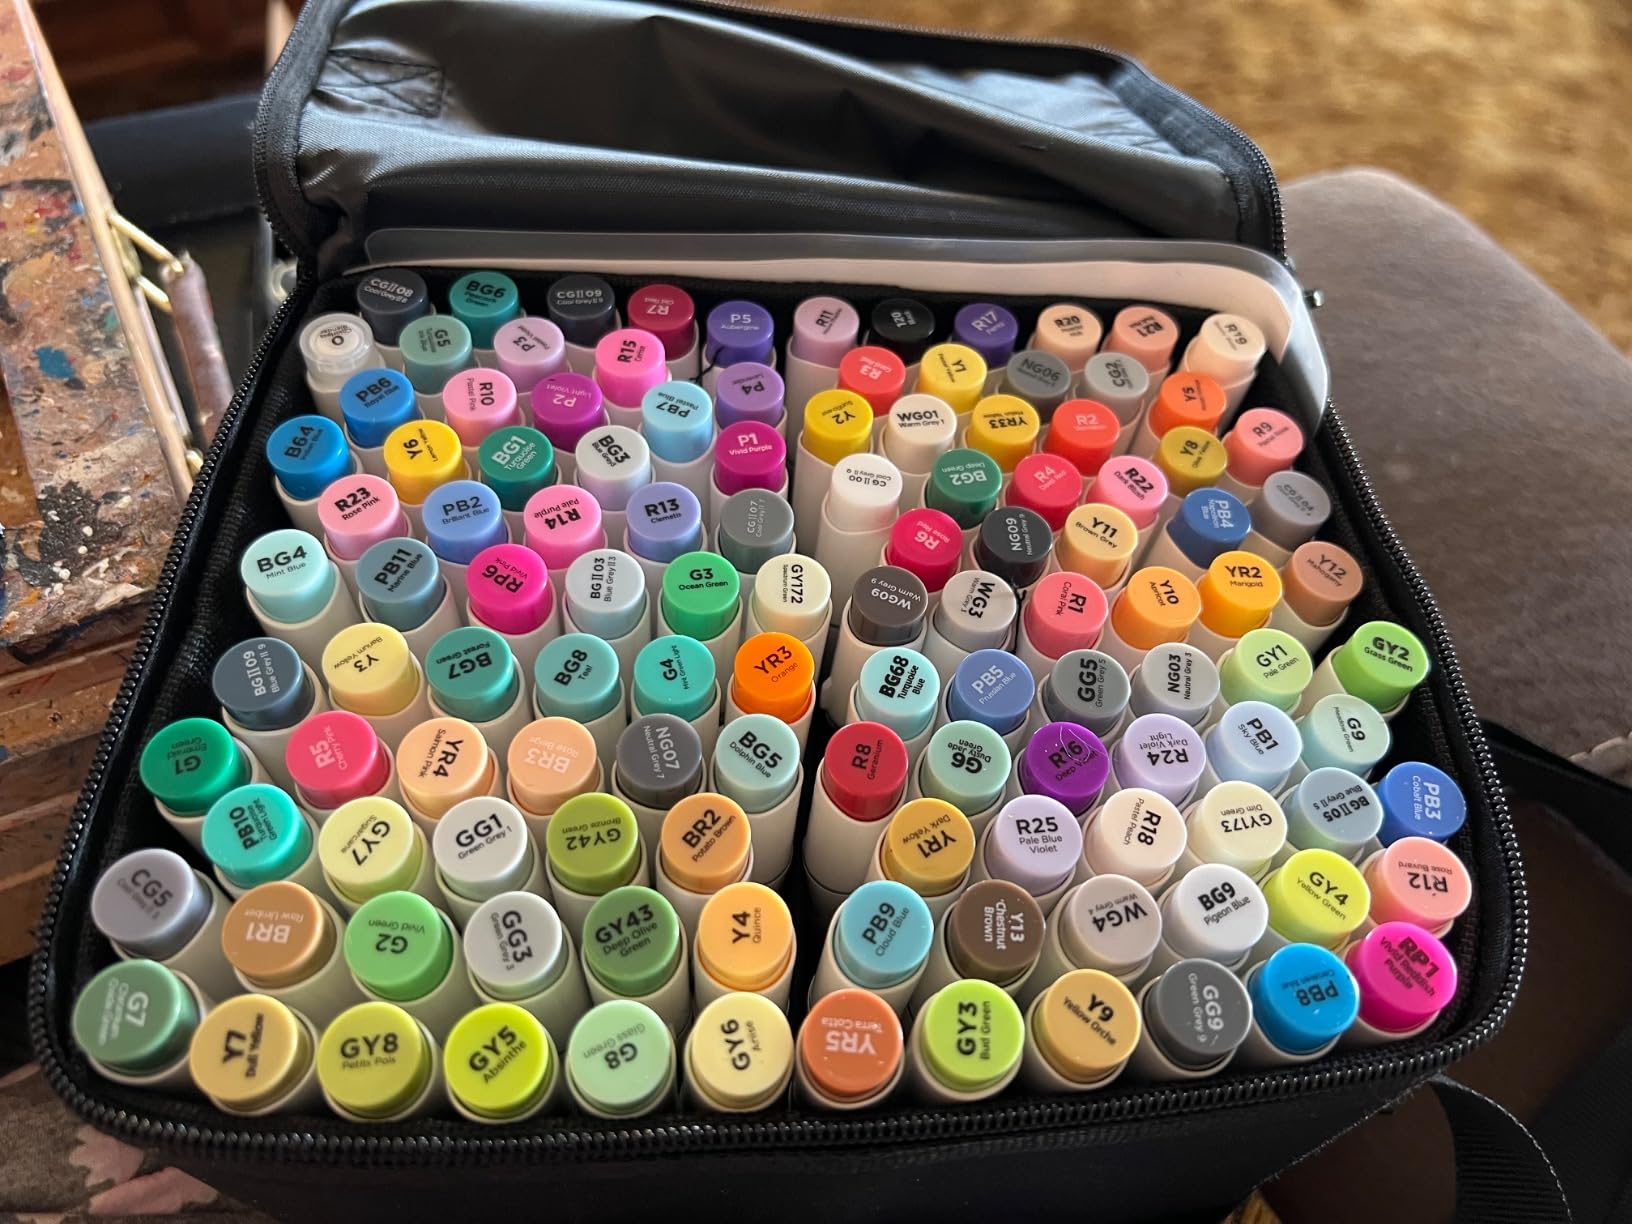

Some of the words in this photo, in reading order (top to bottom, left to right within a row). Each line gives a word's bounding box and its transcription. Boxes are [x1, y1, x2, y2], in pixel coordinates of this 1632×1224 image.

[465, 280, 507, 298] BG6
[646, 306, 670, 315] R7
[731, 314, 752, 323] P5
[816, 310, 835, 327] R11
[971, 311, 998, 332] R17
[1054, 316, 1081, 328] R20
[434, 329, 451, 347] G5
[513, 336, 536, 352] P3
[618, 340, 636, 363] R15
[859, 365, 882, 380] R3
[1021, 359, 1061, 381] NG06
[1106, 361, 1125, 387] CG2
[355, 377, 392, 402] PB6
[479, 382, 494, 406] R10
[741, 381, 765, 394] P4
[553, 394, 577, 407] P2
[656, 402, 692, 418] PB7
[832, 411, 856, 424] Y2
[897, 410, 938, 421] WG01
[989, 418, 1028, 428] YR33
[1075, 414, 1099, 425] R2
[284, 426, 315, 458] B64
[737, 433, 758, 446] P1
[1252, 422, 1273, 437] R9
[403, 438, 423, 460] Y6
[492, 436, 528, 465] BG1
[598, 435, 631, 463] BG3
[728, 447, 748, 456] Vivid
[749, 444, 772, 453] Purple
[1180, 440, 1198, 456] Y8
[517, 451, 537, 471] Green
[950, 470, 987, 486] BG2
[1034, 466, 1056, 483] R4
[1124, 468, 1154, 492] R22
[334, 487, 371, 512] R23
[342, 506, 361, 521] Rose
[362, 496, 380, 509] Pink
[442, 496, 482, 516] PB2
[534, 505, 560, 518] Purple
[560, 498, 579, 508] Pale
[644, 498, 680, 517] R13
[544, 508, 582, 530] R14
[1215, 499, 1234, 528] PB4
[1006, 518, 1022, 551] NG09
[1092, 517, 1117, 537] Y11
[914, 531, 940, 550] R6
[257, 546, 307, 573] BG4
[266, 568, 285, 580] Mint
[287, 562, 306, 573] Blue
[374, 548, 412, 586] PB11
[1225, 565, 1262, 578] YR2
[1319, 554, 1347, 579] Y12
[387, 569, 409, 593] Marine
[407, 553, 423, 570] Blue
[482, 564, 524, 593] RP6
[679, 582, 704, 590] Ocean
[706, 580, 728, 588] Green
[689, 568, 713, 580] G3
[790, 564, 803, 604] GY172
[872, 588, 912, 610] WG09
[968, 581, 995, 620] WG3
[1068, 592, 1087, 614] R1
[1150, 581, 1166, 606] Apricot
[1160, 579, 1179, 605] Y10
[754, 645, 793, 676] YR3
[1256, 644, 1288, 668] GY1
[1364, 646, 1386, 660] Grass
[1387, 655, 1413, 672] Green
[1372, 636, 1410, 661] GY2
[353, 654, 379, 672] Y3
[448, 652, 492, 680] BG7
[554, 649, 588, 686] BG8
[659, 658, 677, 681] G4
[771, 662, 798, 683] Orange
[1168, 654, 1181, 693] NG03
[1263, 666, 1280, 680] Pale
[1278, 656, 1299, 672] Green
[879, 654, 909, 698] BG68
[897, 664, 919, 700] Turquoise
[912, 678, 926, 695] Blue
[971, 664, 1004, 694] PB5
[1078, 658, 1098, 702] GG5
[1246, 718, 1279, 750] PB1
[1347, 717, 1366, 741] G9
[309, 739, 336, 769] R5
[433, 739, 464, 778] YR4
[656, 726, 680, 770] NG07
[738, 731, 782, 768] BG5
[852, 744, 871, 769] R8
[959, 740, 983, 752] Green
[1146, 749, 1189, 766] R24
[174, 755, 202, 776] G1
[523, 748, 571, 774] BR3
[729, 741, 756, 765] Dolphin
[755, 763, 772, 778] Blue
[868, 740, 884, 780] Geranium
[951, 752, 983, 774] G6
[1423, 782, 1441, 820] PB3
[229, 807, 258, 850] PB10
[455, 813, 504, 848] GG1
[682, 808, 722, 848] BR2
[1016, 816, 1058, 835] R25
[1137, 810, 1162, 846] R18
[1220, 813, 1272, 833] GY173
[351, 820, 391, 866] GY7
[566, 828, 621, 851] GY42
[691, 836, 716, 863] Potato
[715, 814, 737, 838] Brown
[917, 830, 957, 858] YR1
[1019, 836, 1040, 845] Pale
[1042, 834, 1063, 844] Blue
[1029, 844, 1058, 854] Violet
[131, 868, 174, 908] CG5
[1309, 871, 1349, 906] GY4
[1407, 872, 1448, 894] R12
[1198, 882, 1236, 912] BG9
[1296, 877, 1322, 900] Yellow
[1322, 898, 1346, 921] Green
[862, 902, 895, 944] PB9
[1091, 902, 1148, 932] WG4
[1204, 903, 1232, 926] Pigeon
[1233, 896, 1251, 912] Blue
[245, 922, 292, 944] BR1
[502, 910, 534, 963] GG3
[594, 904, 654, 944] GY43
[732, 911, 751, 944] Y4
[752, 907, 761, 944] Quince
[874, 927, 897, 957] Cloud
[894, 907, 910, 928] Blue
[984, 906, 994, 942] Brown
[1010, 912, 1024, 942] Y13
[375, 933, 408, 954] G2
[602, 936, 631, 955] Deep
[631, 922, 658, 940] Olive
[620, 937, 651, 958] Green
[1398, 936, 1440, 978] RP1
[1296, 980, 1338, 1006] PB8
[125, 992, 150, 1028] G7
[1088, 994, 1114, 1022] Y9
[1202, 985, 1224, 1031] GG9
[956, 1001, 978, 1056] GY3
[223, 1030, 246, 1063] Y7
[340, 1033, 398, 1058] GY8
[469, 1026, 518, 1072] GY5
[721, 1018, 751, 1070] GY6
[826, 1030, 877, 1055] YR5
[980, 1038, 990, 1060] Bud
[482, 1041, 527, 1084] Absinthe
[604, 1042, 638, 1070] G8
